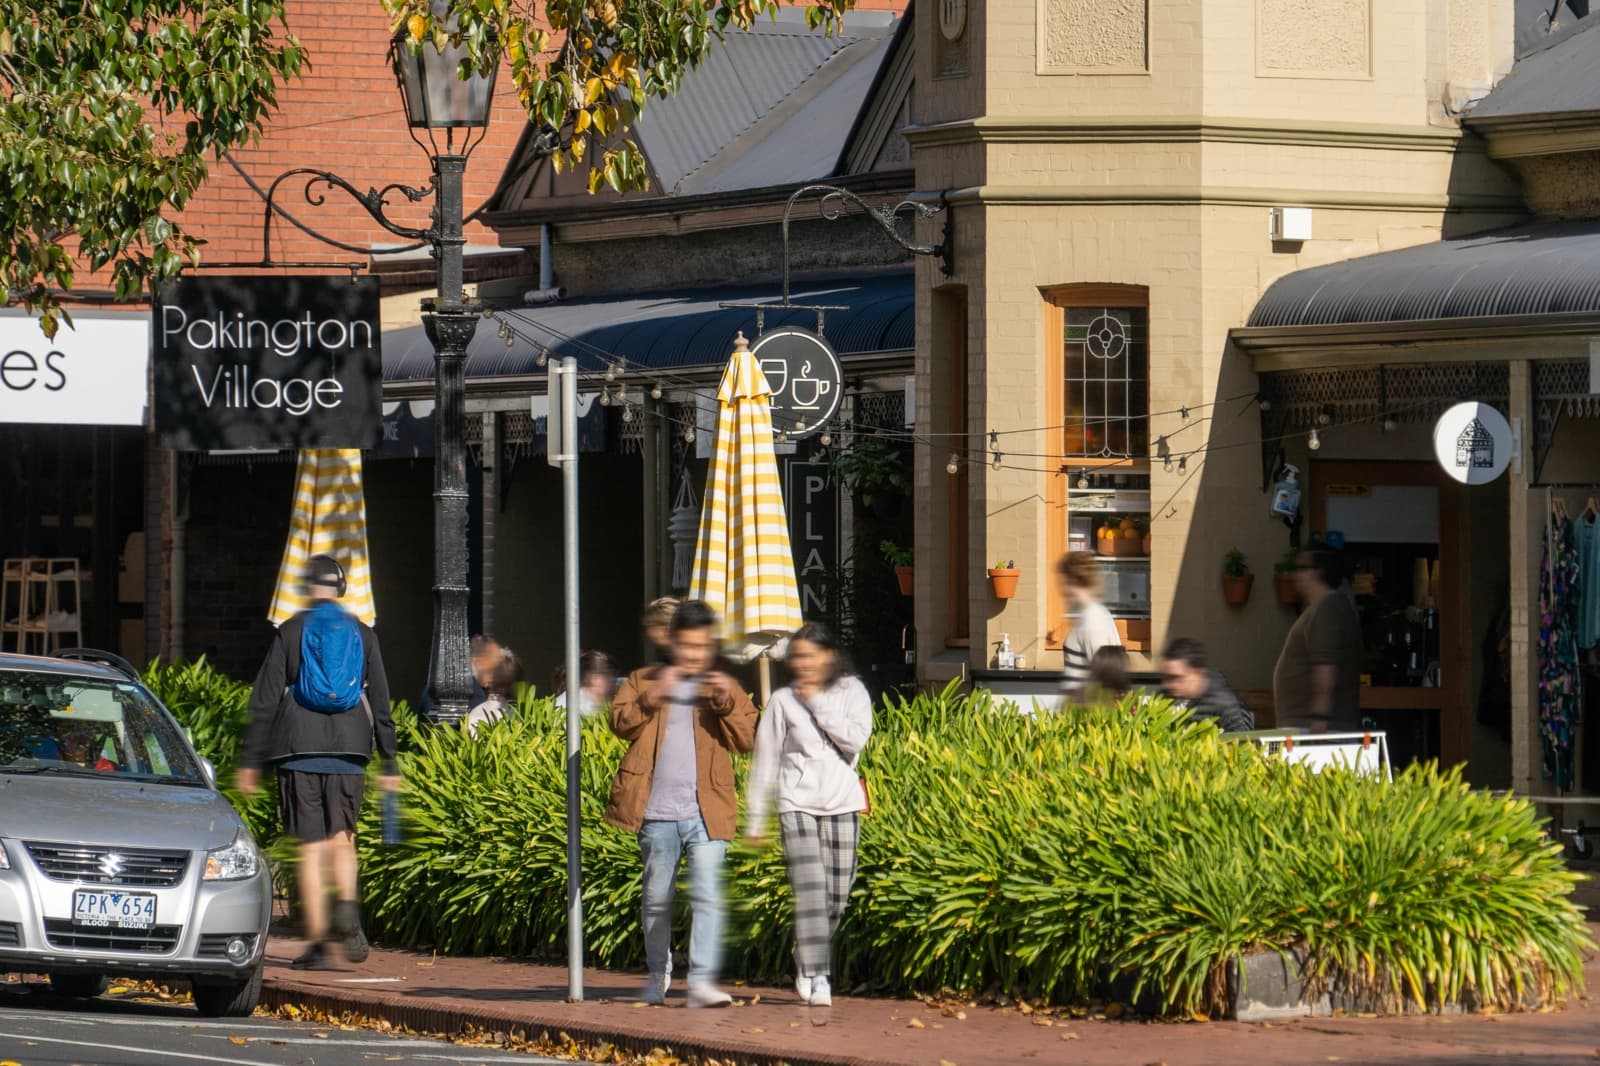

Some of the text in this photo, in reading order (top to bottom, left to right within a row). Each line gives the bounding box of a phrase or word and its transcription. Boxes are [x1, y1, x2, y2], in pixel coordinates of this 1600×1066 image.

[162, 304, 373, 356] Pakington
[191, 364, 344, 416] Village
[77, 894, 153, 917] ZPK 654
